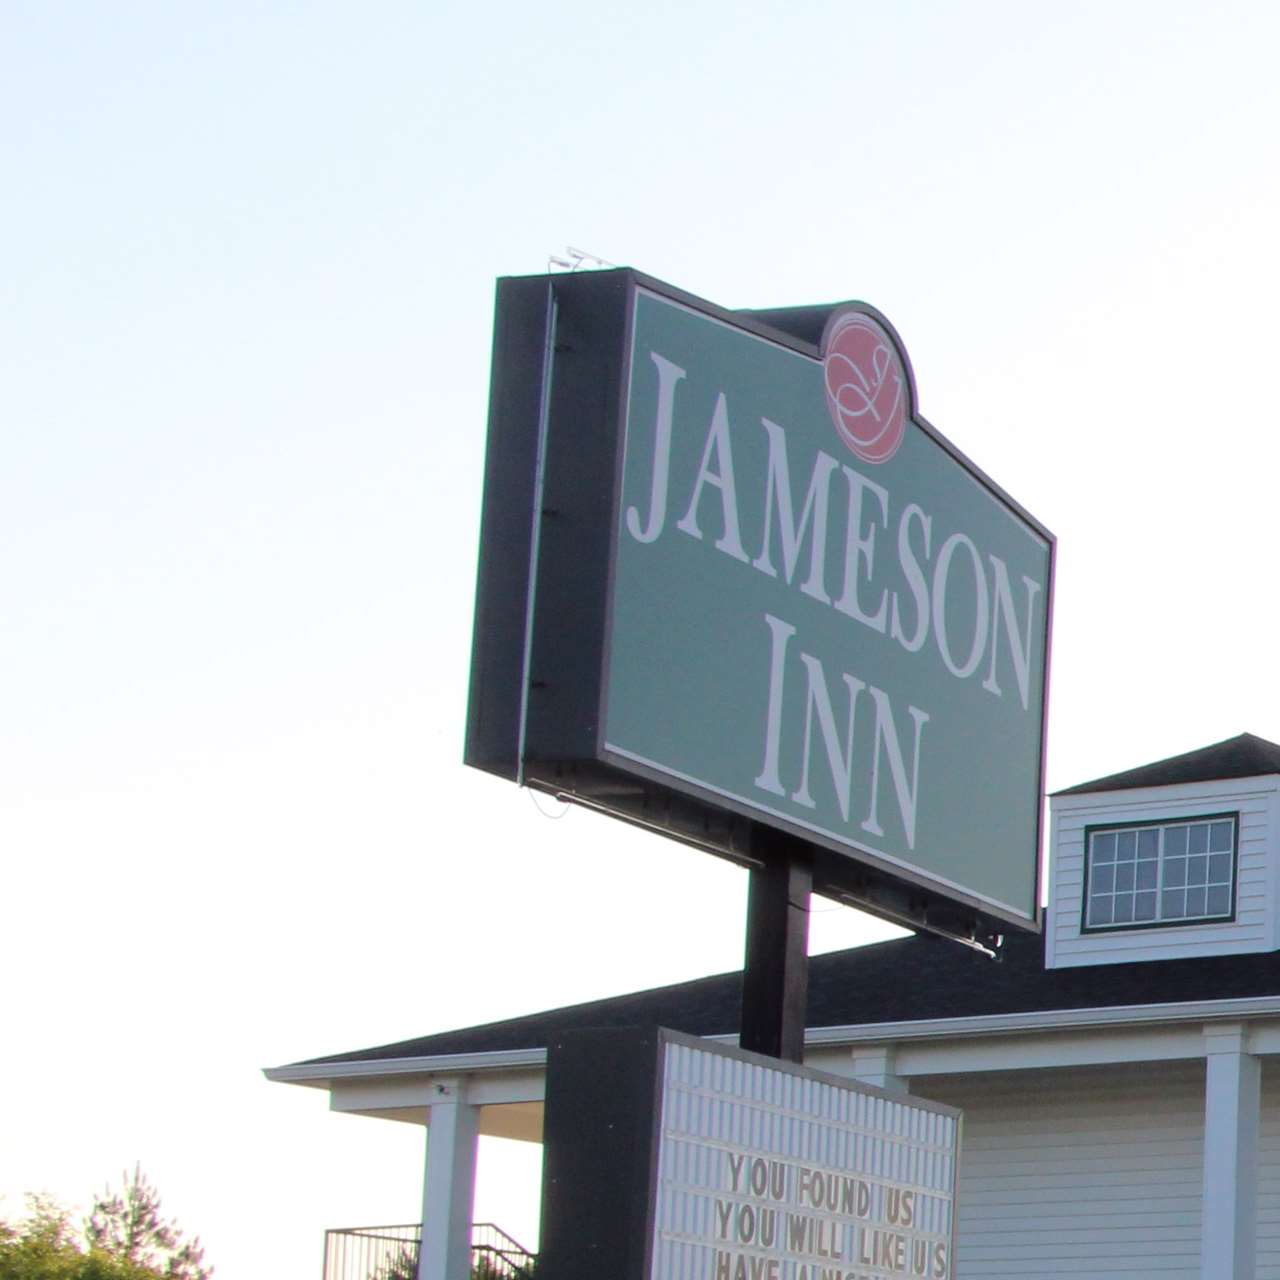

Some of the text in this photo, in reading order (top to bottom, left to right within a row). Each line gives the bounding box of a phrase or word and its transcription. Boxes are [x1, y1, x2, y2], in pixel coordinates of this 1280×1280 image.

[627, 351, 1041, 711] JAMESON
[754, 613, 930, 850] INN
[716, 1199, 946, 1278] YOU WILL LIKE US
[729, 1152, 914, 1226] YOU FOUND US
